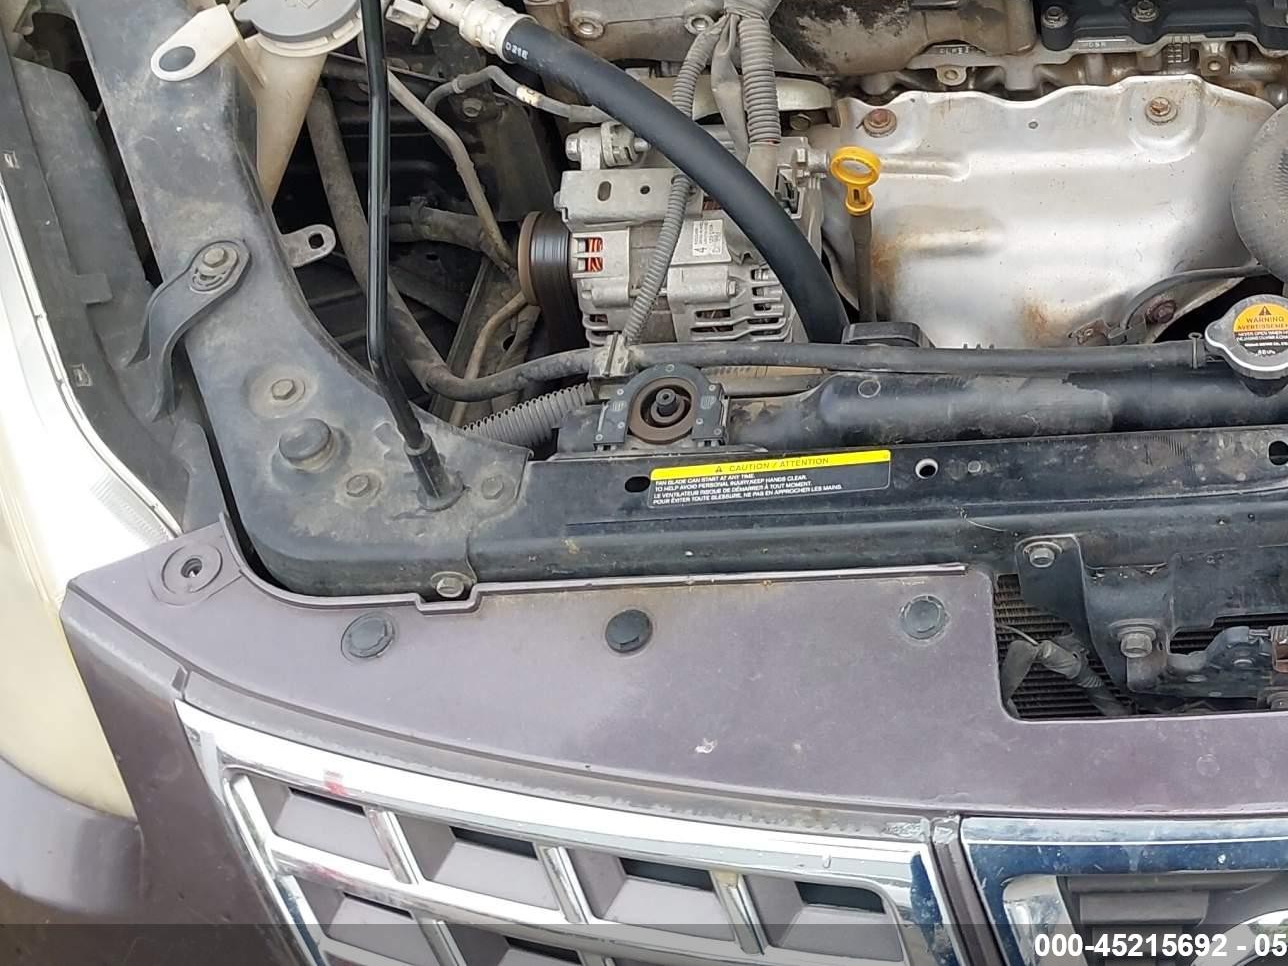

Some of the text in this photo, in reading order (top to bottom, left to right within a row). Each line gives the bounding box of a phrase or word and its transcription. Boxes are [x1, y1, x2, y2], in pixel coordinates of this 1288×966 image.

[1246, 316, 1285, 324] WARNING
[729, 462, 769, 471] CAUTION
[778, 457, 828, 467] ATTENTION
